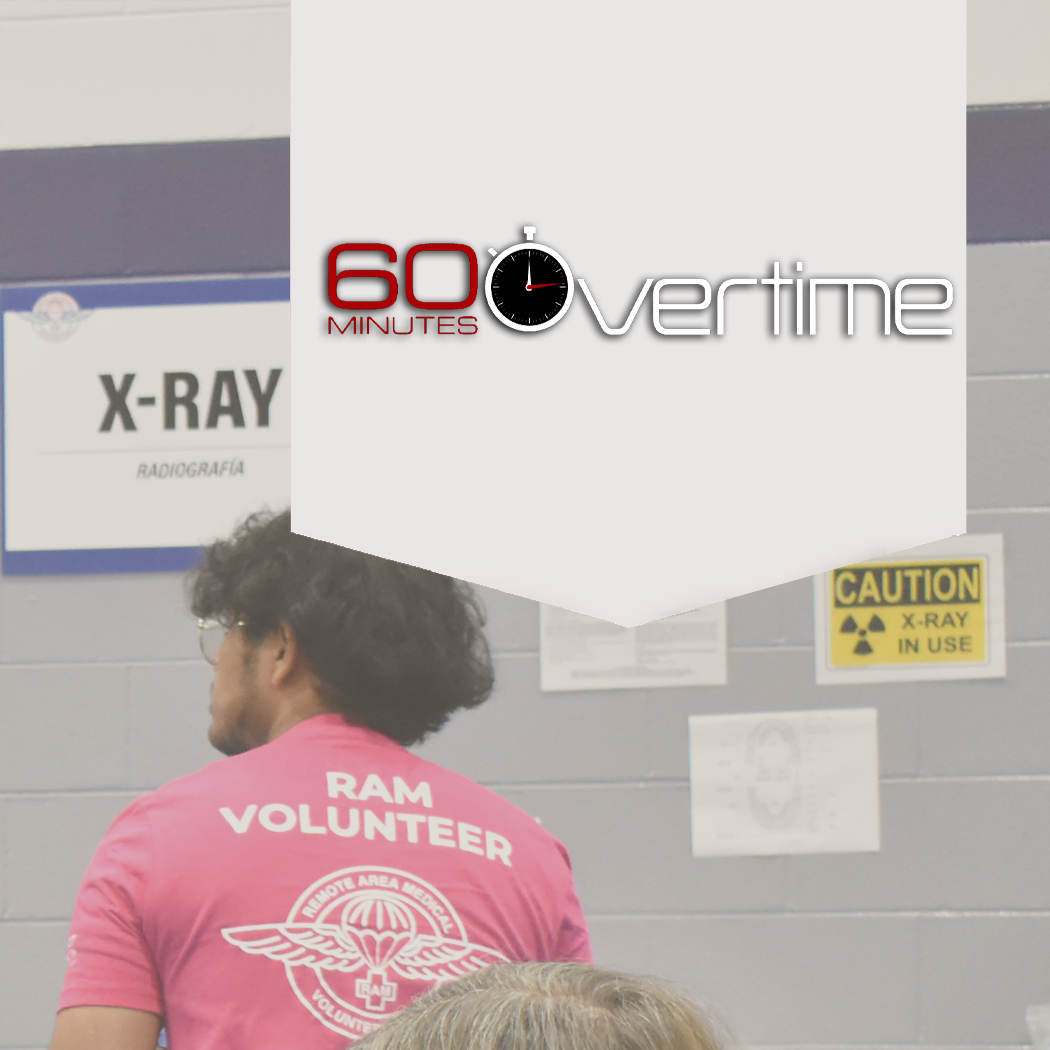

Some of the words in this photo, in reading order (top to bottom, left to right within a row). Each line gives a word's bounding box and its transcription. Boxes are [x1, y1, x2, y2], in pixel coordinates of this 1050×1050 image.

[98, 368, 284, 433] X-RAY
[136, 457, 246, 480] RADIOGRAFÍA
[835, 566, 980, 605] CAUTION
[901, 611, 968, 630] X-RAY
[898, 638, 919, 654] IN
[928, 636, 972, 653] USE
[326, 771, 433, 808] RAM
[218, 803, 512, 868] VOLUNTEER
[302, 877, 356, 919] REMOTE
[358, 875, 399, 889] AREA
[401, 882, 455, 935] MEDICAL
[361, 983, 392, 996] RAM
